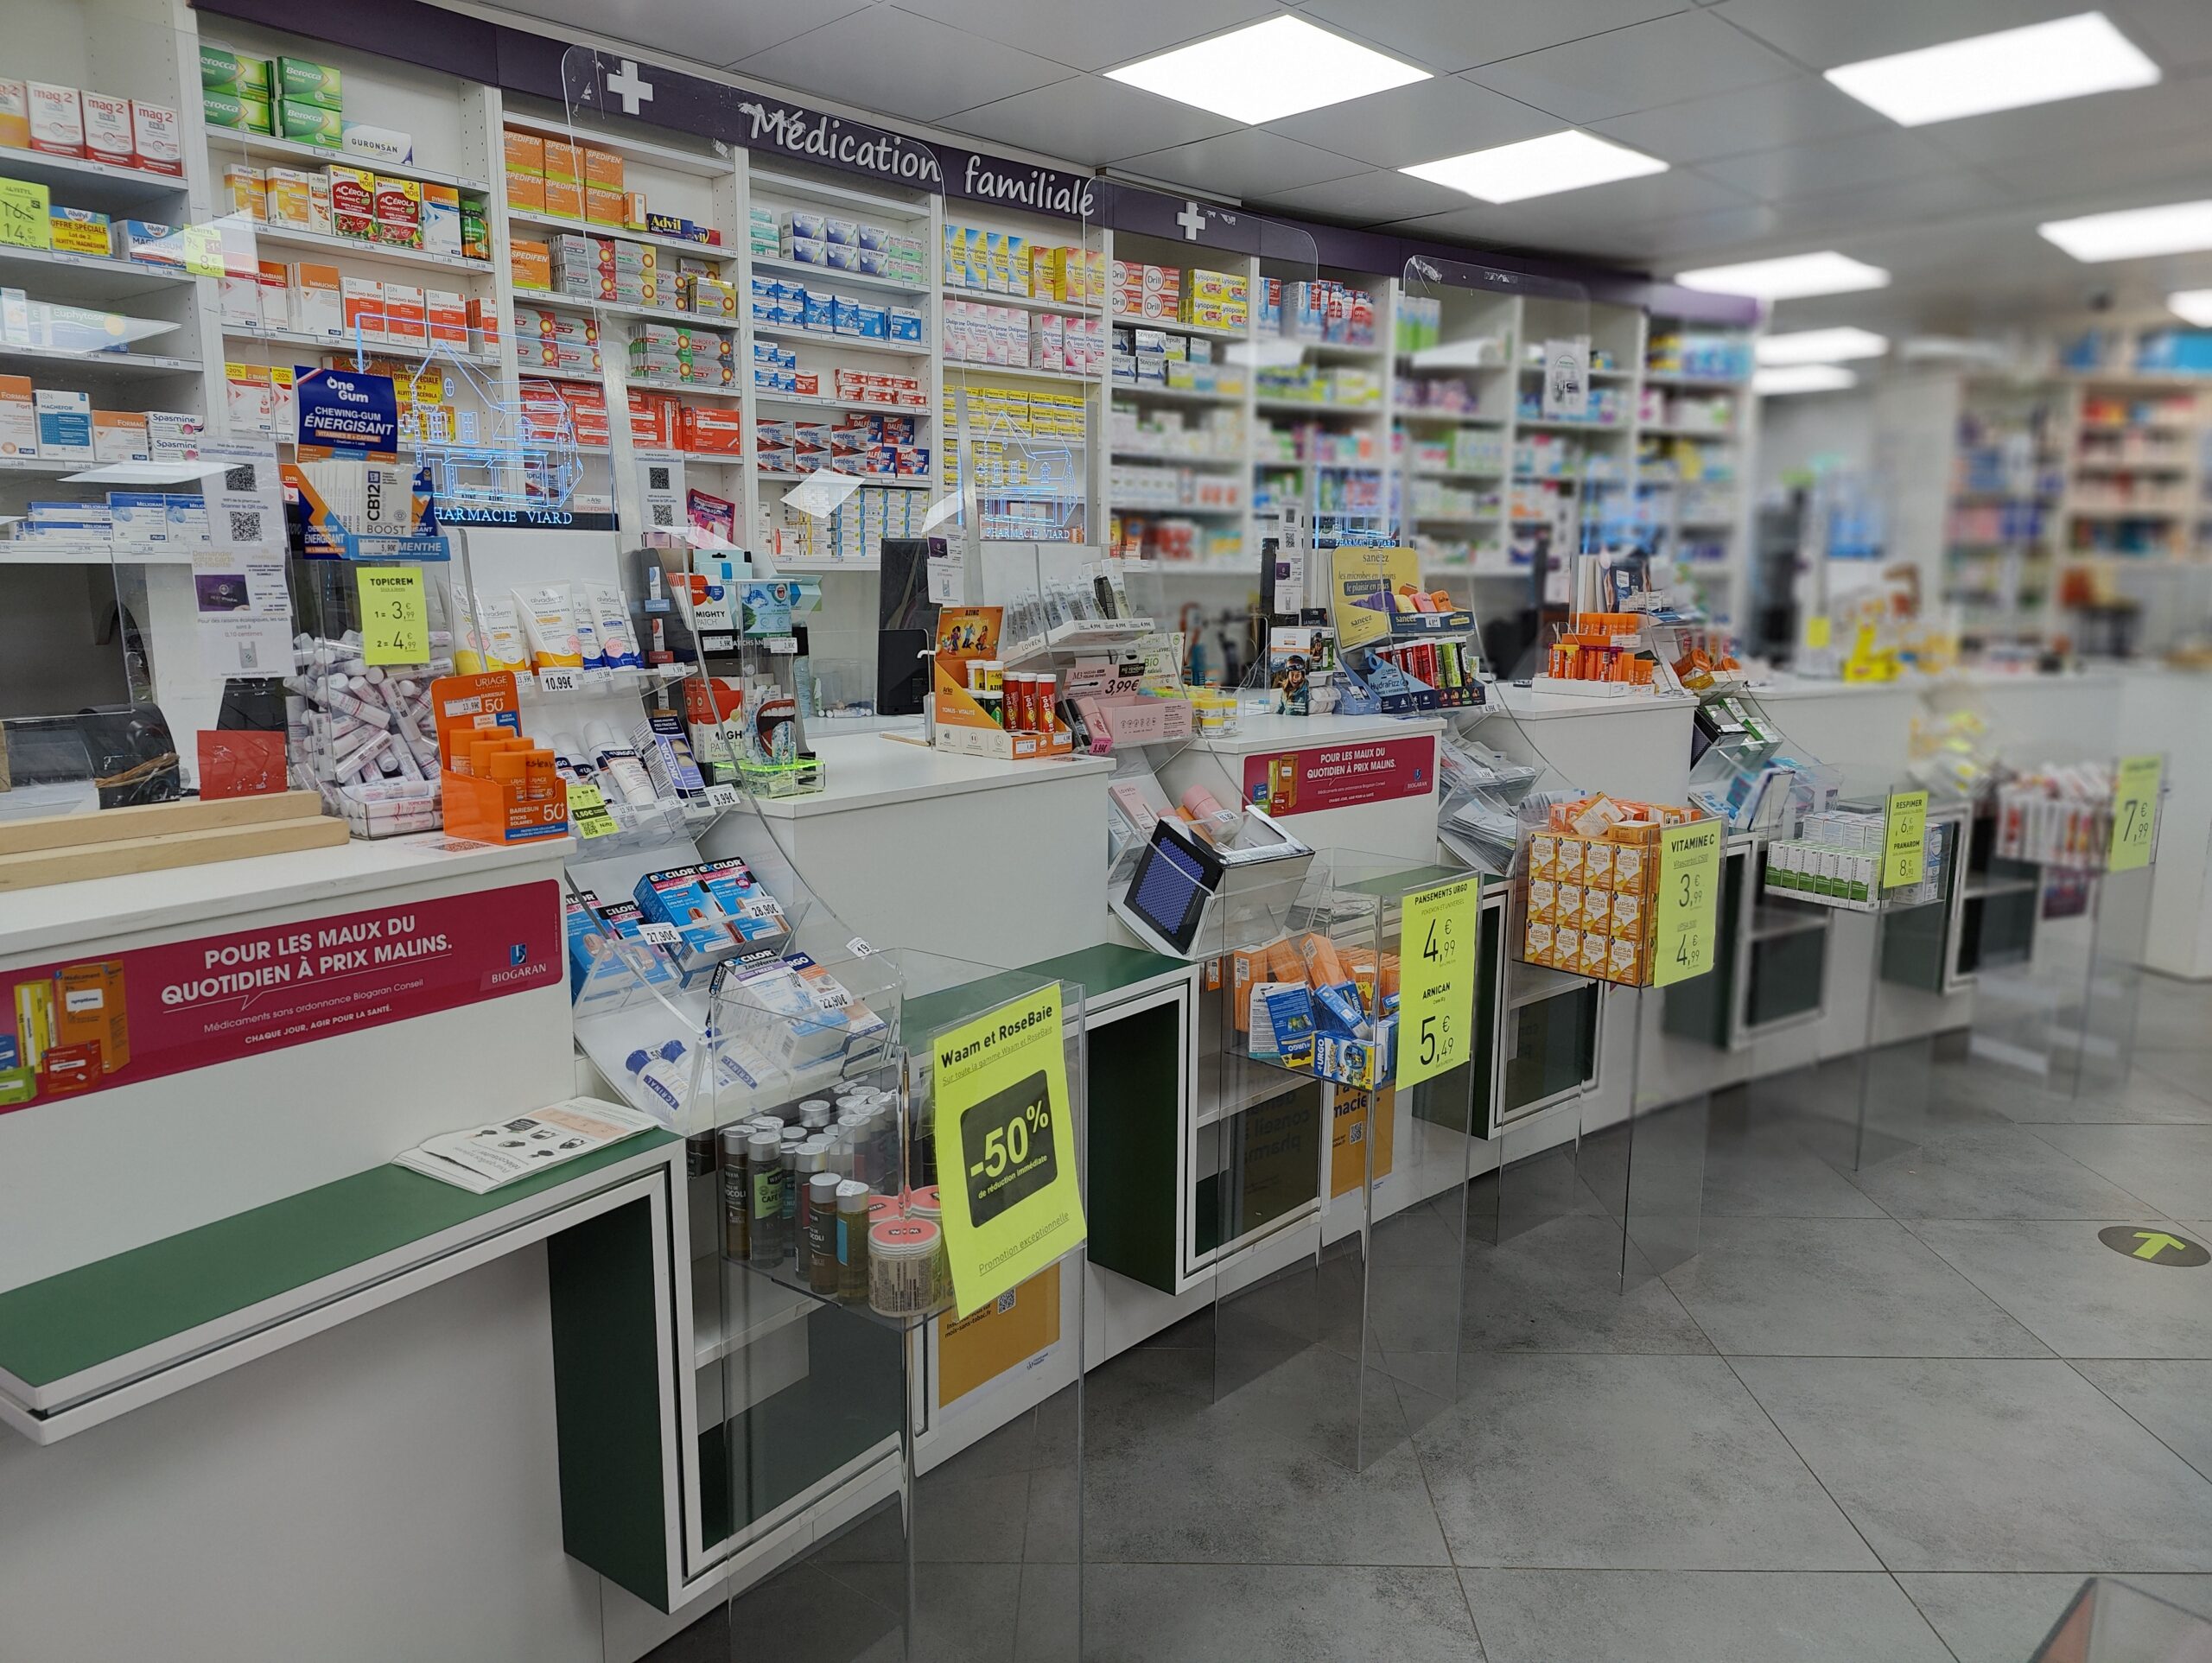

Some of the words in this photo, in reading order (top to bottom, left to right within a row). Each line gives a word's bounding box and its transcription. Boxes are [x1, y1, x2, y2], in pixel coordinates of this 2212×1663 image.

[200, 55, 237, 71] erocca
[286, 67, 321, 81] Berocca
[88, 98, 113, 114] mag
[116, 103, 124, 113] 2
[138, 106, 163, 123] mag
[164, 111, 173, 123] 2
[288, 109, 322, 123] Berocca
[352, 138, 398, 154] GURONSAN
[587, 149, 621, 164] SPEDIFEN
[751, 103, 941, 182] Médication
[964, 155, 1095, 216] familiale
[359, 180, 374, 188] MOIS
[588, 187, 622, 200] SPEDIFEN
[50, 219, 73, 229] OFFRE
[650, 215, 682, 230] Advil
[1147, 276, 1161, 285] Drill
[1147, 302, 1160, 311] Drill
[327, 377, 355, 391] One
[1, 392, 30, 401] FORMAG
[339, 390, 369, 403] Gum
[152, 413, 195, 424] Spasmine
[315, 406, 381, 422] CHEWING-GUM
[304, 414, 394, 436] ÉNERGISANT
[156, 440, 197, 450] Spasmine
[367, 484, 380, 521] CB12
[434, 506, 518, 524] HARMACIE
[526, 510, 573, 524] VIARD
[366, 524, 406, 535] BOOST
[985, 527, 1038, 539] PHARMACIE
[1043, 529, 1070, 539] VIARD
[398, 543, 442, 552] MENTHE
[370, 578, 414, 587] TOPICREM
[1347, 571, 1372, 580] microbes
[475, 675, 507, 687] URIAGE
[545, 676, 573, 691] 10,99€
[1105, 678, 1140, 695] 3,99€
[661, 742, 680, 781] AKILDIA
[1320, 753, 1340, 764] POUR
[1341, 751, 1352, 760] LES
[1354, 748, 1375, 759] MAUX
[1376, 747, 1385, 757] DU
[1306, 765, 1345, 779] QUOTIDIEN
[1346, 763, 1352, 773] À
[1353, 762, 1370, 772] PRIX
[1370, 759, 1396, 771] MALINS.
[714, 793, 736, 806] 9,99€
[1896, 799, 1923, 809] RESPIMER
[510, 806, 539, 815] BARIESUN
[1561, 846, 1580, 854] UPSA
[1671, 835, 1707, 853] VITAMINE
[1709, 835, 1715, 846] C
[1894, 840, 1920, 850] PRANAROM
[1414, 887, 1452, 905] PANSEMENTS
[1453, 883, 1468, 895] URGO
[607, 904, 636, 917] CILOR
[751, 904, 779, 917] 28,90€
[205, 941, 270, 969] POUR
[278, 933, 312, 955] LES
[319, 921, 382, 949] MAUX
[388, 915, 416, 936] DU
[647, 930, 677, 943] 27,90€
[788, 955, 810, 968] RGO
[162, 963, 290, 1006] QUOTIDIEN
[297, 955, 314, 979] À
[321, 949, 368, 974] PRIX
[374, 934, 453, 963] MALINS.
[492, 963, 546, 984] BIOGARAN
[1422, 981, 1451, 1000] ARNICAN
[204, 1012, 270, 1033] Médicaments
[273, 1006, 295, 1018] sans
[296, 993, 352, 1013] ordonnance
[353, 986, 392, 1003] Biogaran
[394, 979, 424, 992] Conseil
[823, 994, 848, 1009] 22,90€
[245, 1030, 282, 1044] CHAQUE
[283, 1024, 308, 1036] JOUR,
[310, 1018, 331, 1029] AGIR
[333, 1012, 354, 1024] POUR
[356, 1010, 365, 1019] LA
[366, 1004, 392, 1017] SANTÉ.
[941, 1041, 981, 1070] Waam
[983, 1031, 996, 1046] et
[999, 1006, 1053, 1039] RoseBaie
[1288, 1041, 1306, 1052] URGO
[724, 1057, 753, 1085] ECRINAL
[942, 1074, 953, 1086] Sur
[954, 1065, 970, 1080] toute
[978, 1054, 1001, 1071] gamme
[1001, 1043, 1020, 1058] Waam
[648, 1077, 677, 1107] ECRINAL
[970, 1100, 1049, 1178] -50%
[978, 1189, 986, 1199] de
[988, 1173, 1016, 1196] réduction
[1017, 1154, 1048, 1181] immédiate
[979, 1240, 1019, 1274] Promotion
[1019, 1211, 1070, 1249] exceptionnelle
